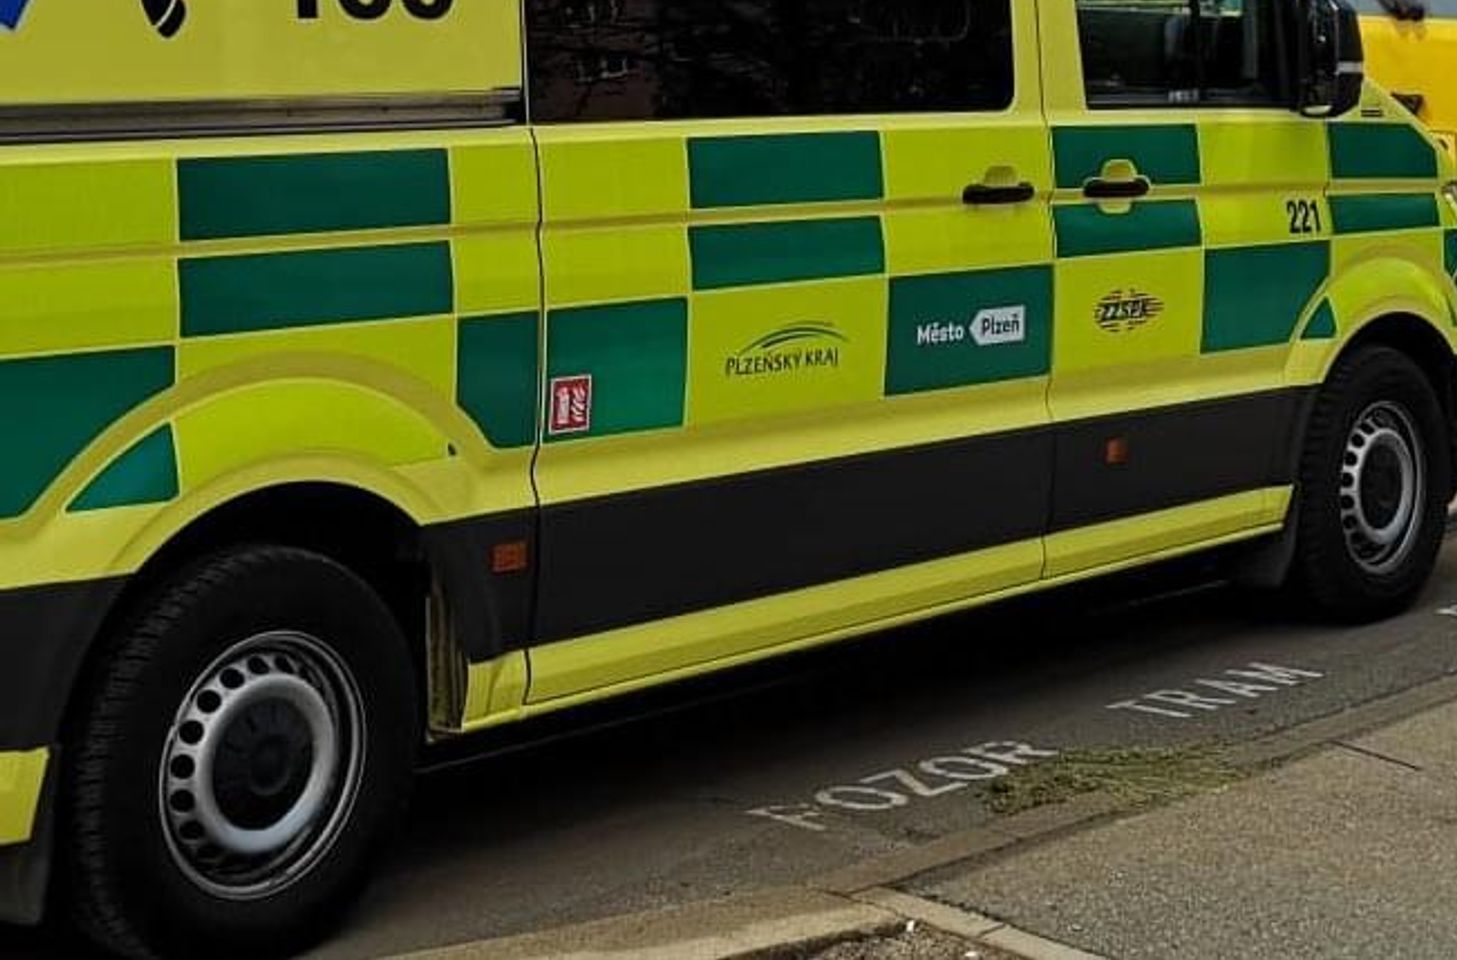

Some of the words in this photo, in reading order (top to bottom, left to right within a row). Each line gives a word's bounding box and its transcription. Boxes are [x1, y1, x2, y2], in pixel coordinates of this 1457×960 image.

[1286, 199, 1322, 234] 221
[917, 322, 964, 344] Město
[981, 313, 1021, 336] Plzeň
[746, 738, 1059, 831] POZOR
[1106, 661, 1325, 718] TRAM
